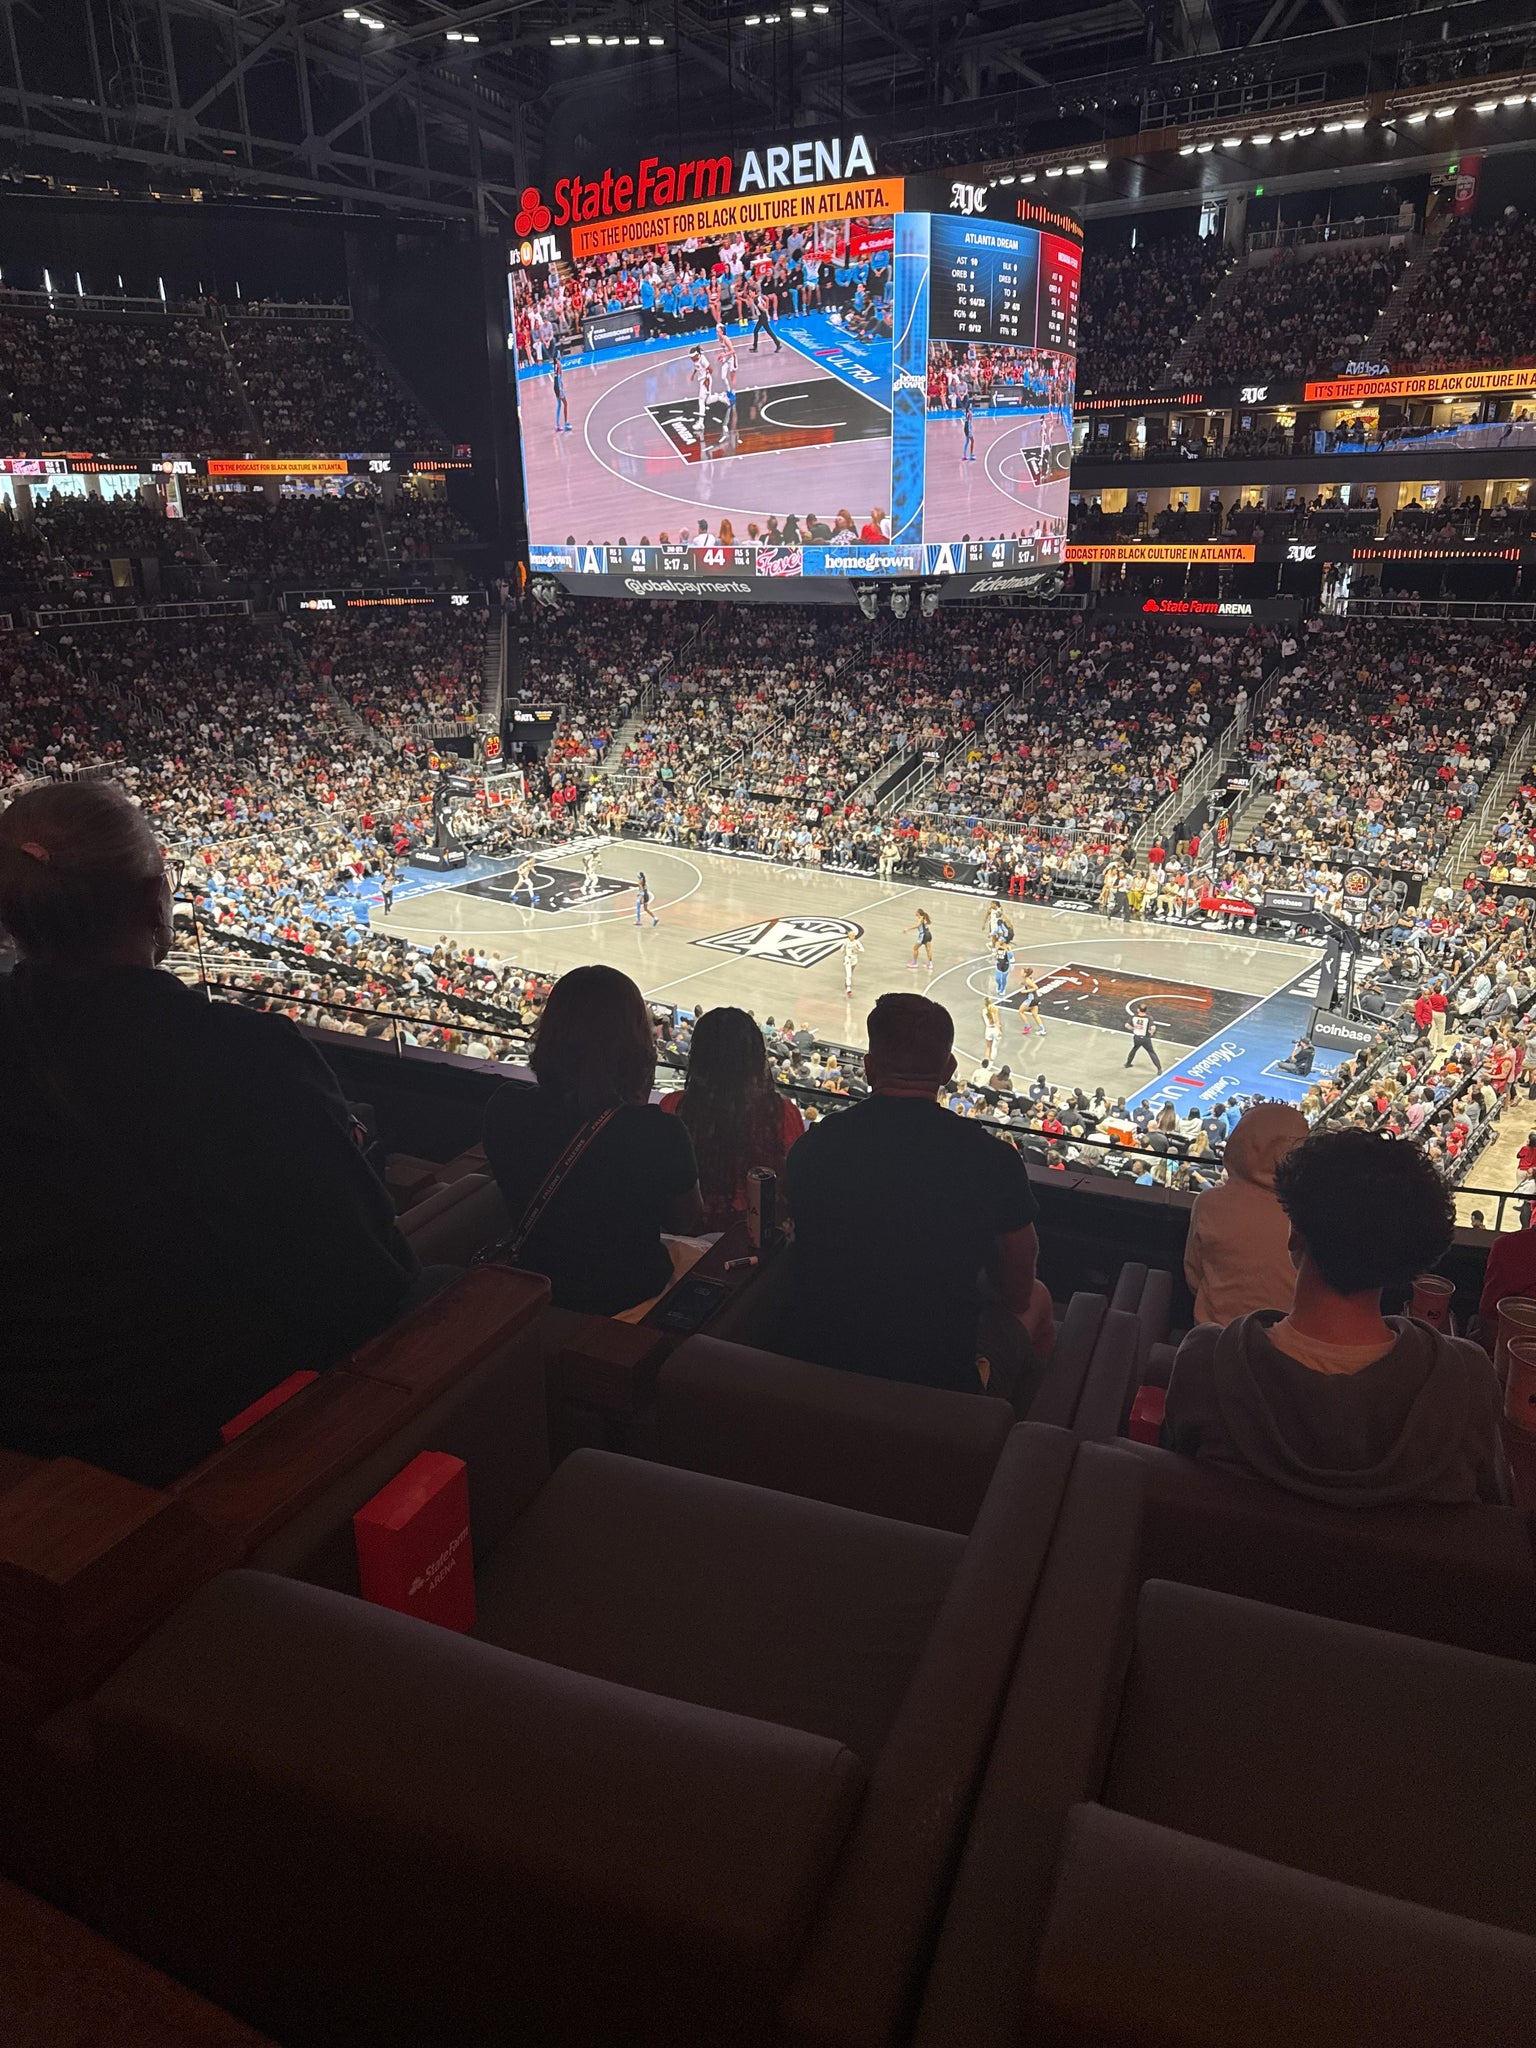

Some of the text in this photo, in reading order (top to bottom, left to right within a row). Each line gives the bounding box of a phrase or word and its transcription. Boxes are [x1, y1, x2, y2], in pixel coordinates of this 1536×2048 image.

[738, 135, 876, 192] ARENA
[950, 183, 988, 215] AJC
[580, 188, 889, 250] IT'S THE PODCAST FOR BLACK CULTURE IN ATLANTA.
[965, 233, 1019, 250] ATLANTA DREAM
[956, 256, 968, 265] AST
[956, 283, 967, 292] STL
[1004, 288, 1011, 297] TO
[958, 296, 967, 305] FG
[959, 323, 966, 331] FT
[826, 354, 881, 384] ULTRA
[1314, 385, 1333, 398] IT'S
[1335, 384, 1354, 396] THE
[1356, 381, 1402, 395] PODCAST
[1406, 380, 1425, 392] FOR
[1428, 377, 1463, 391] BLACK
[1465, 374, 1514, 389] CULTURE
[1516, 373, 1528, 385] IN
[1240, 386, 1268, 404] AJC
[992, 543, 1005, 560] 41
[1041, 540, 1051, 555] 44
[1065, 548, 1246, 560] ODCAST FOR BLACK CULTURE IN ATLANTA.
[1287, 545, 1317, 562] AJC
[583, 547, 600, 573] A
[631, 549, 646, 565] 41
[664, 558, 681, 570] 5:17
[703, 549, 726, 565] 44
[824, 553, 914, 576] homegrown
[933, 545, 956, 574] A
[1018, 551, 1030, 563] 5:17
[1218, 603, 1252, 615] ARENA
[1315, 1023, 1372, 1043] coinbase
[429, 1558, 457, 1593] ARENA
